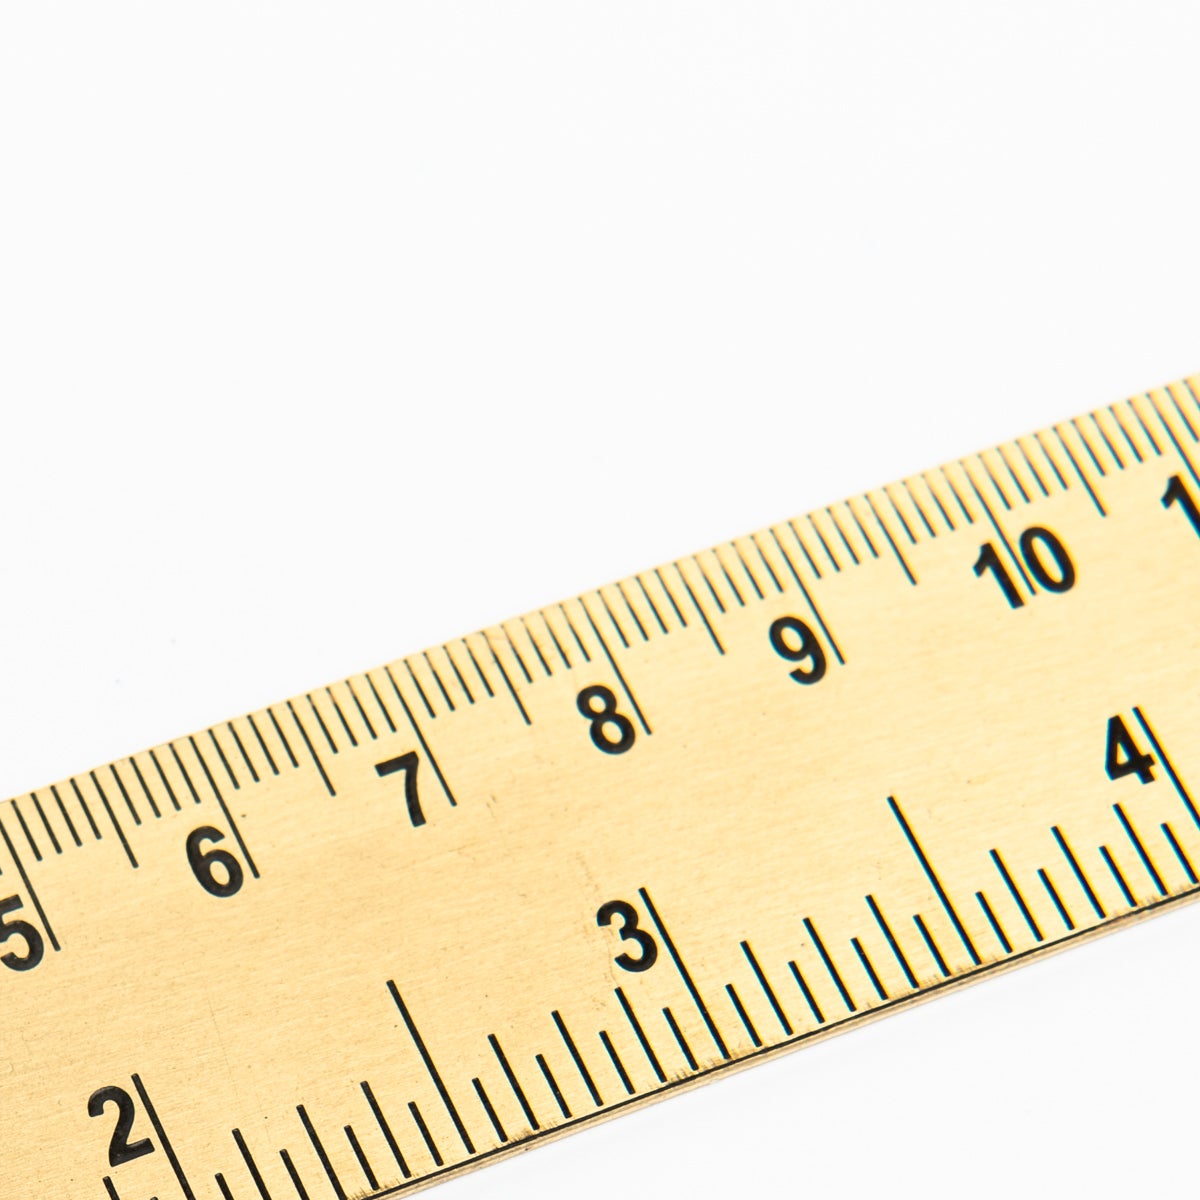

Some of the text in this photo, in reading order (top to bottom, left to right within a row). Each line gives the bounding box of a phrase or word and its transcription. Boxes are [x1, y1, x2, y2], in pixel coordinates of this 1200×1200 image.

[973, 526, 1077, 608] 10
[769, 616, 828, 685] 9
[576, 684, 636, 755] 8
[1105, 714, 1156, 785] 4
[374, 750, 427, 828] 7
[185, 825, 245, 899] 6
[595, 899, 658, 974] 3
[86, 1085, 156, 1169] 2
